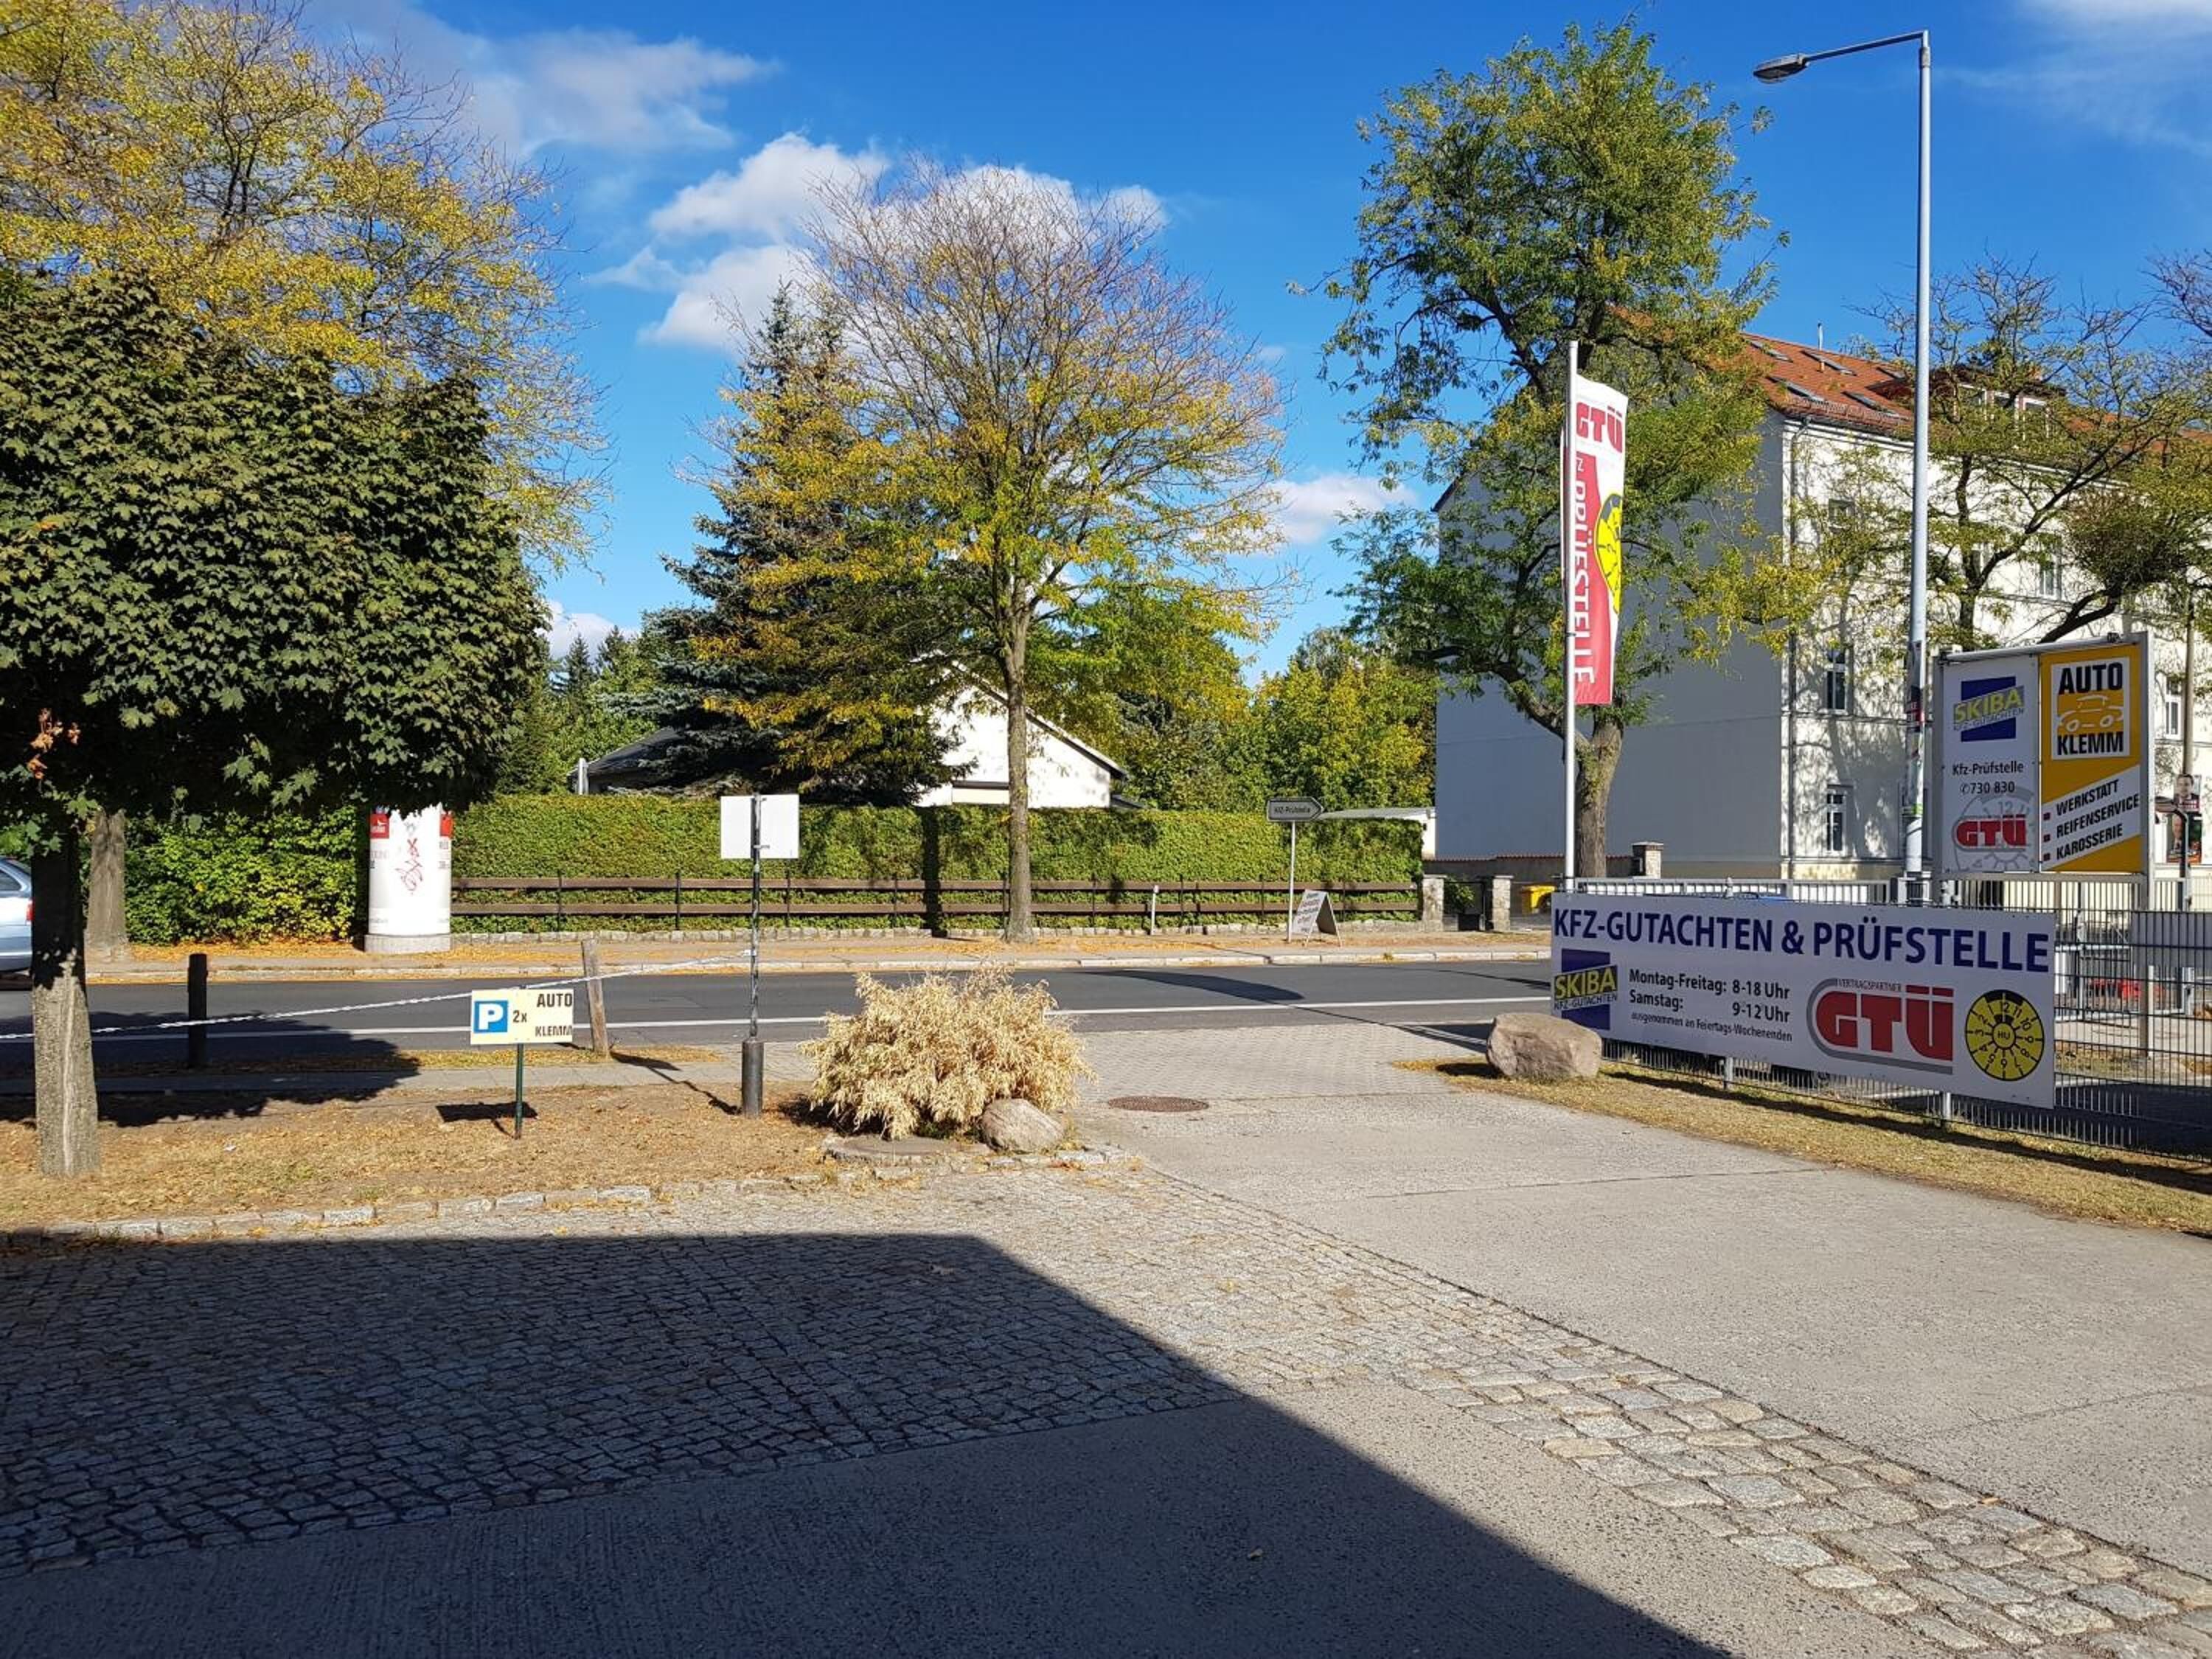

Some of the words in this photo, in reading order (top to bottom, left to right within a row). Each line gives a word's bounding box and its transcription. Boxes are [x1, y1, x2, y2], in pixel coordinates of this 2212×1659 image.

[1576, 402, 1623, 453] GTÜ
[2058, 662, 2123, 695] AUTO
[1954, 689, 2022, 724] SKIBA
[2057, 731, 2124, 755] KLEMM
[1953, 760, 2024, 776] Kfz-Prüfstelle
[1970, 782, 1991, 794] 730
[1994, 781, 2015, 793] 830
[2056, 779, 2120, 816] WERKSTATT
[1957, 814, 2026, 847] GTÜ
[2056, 793, 2139, 838] REIFENSERVICE
[2056, 824, 2124, 860] KAROSSERIE
[1554, 908, 1773, 953] KFZ-GUTACHTEN
[1781, 920, 1805, 954] &
[1813, 916, 2049, 973] PRÜFSTELLE
[1556, 967, 1616, 999] SKIBA
[1629, 968, 1727, 995] Montag-Freitag:
[1732, 979, 1761, 996] 8-18
[1764, 982, 1791, 999] Uhr
[536, 992, 573, 1008] AUTO
[1630, 989, 1683, 1012] Samstag:
[1732, 1002, 1761, 1020] 9-12
[1764, 1005, 1791, 1023] Uhr
[479, 1003, 504, 1031] P
[512, 1009, 528, 1023] 2x
[535, 1026, 573, 1037] KLEMM
[1630, 1012, 1683, 1027] ausgenommen
[1815, 984, 1954, 1062] GTÜ
[1997, 1031, 2011, 1040] HU
